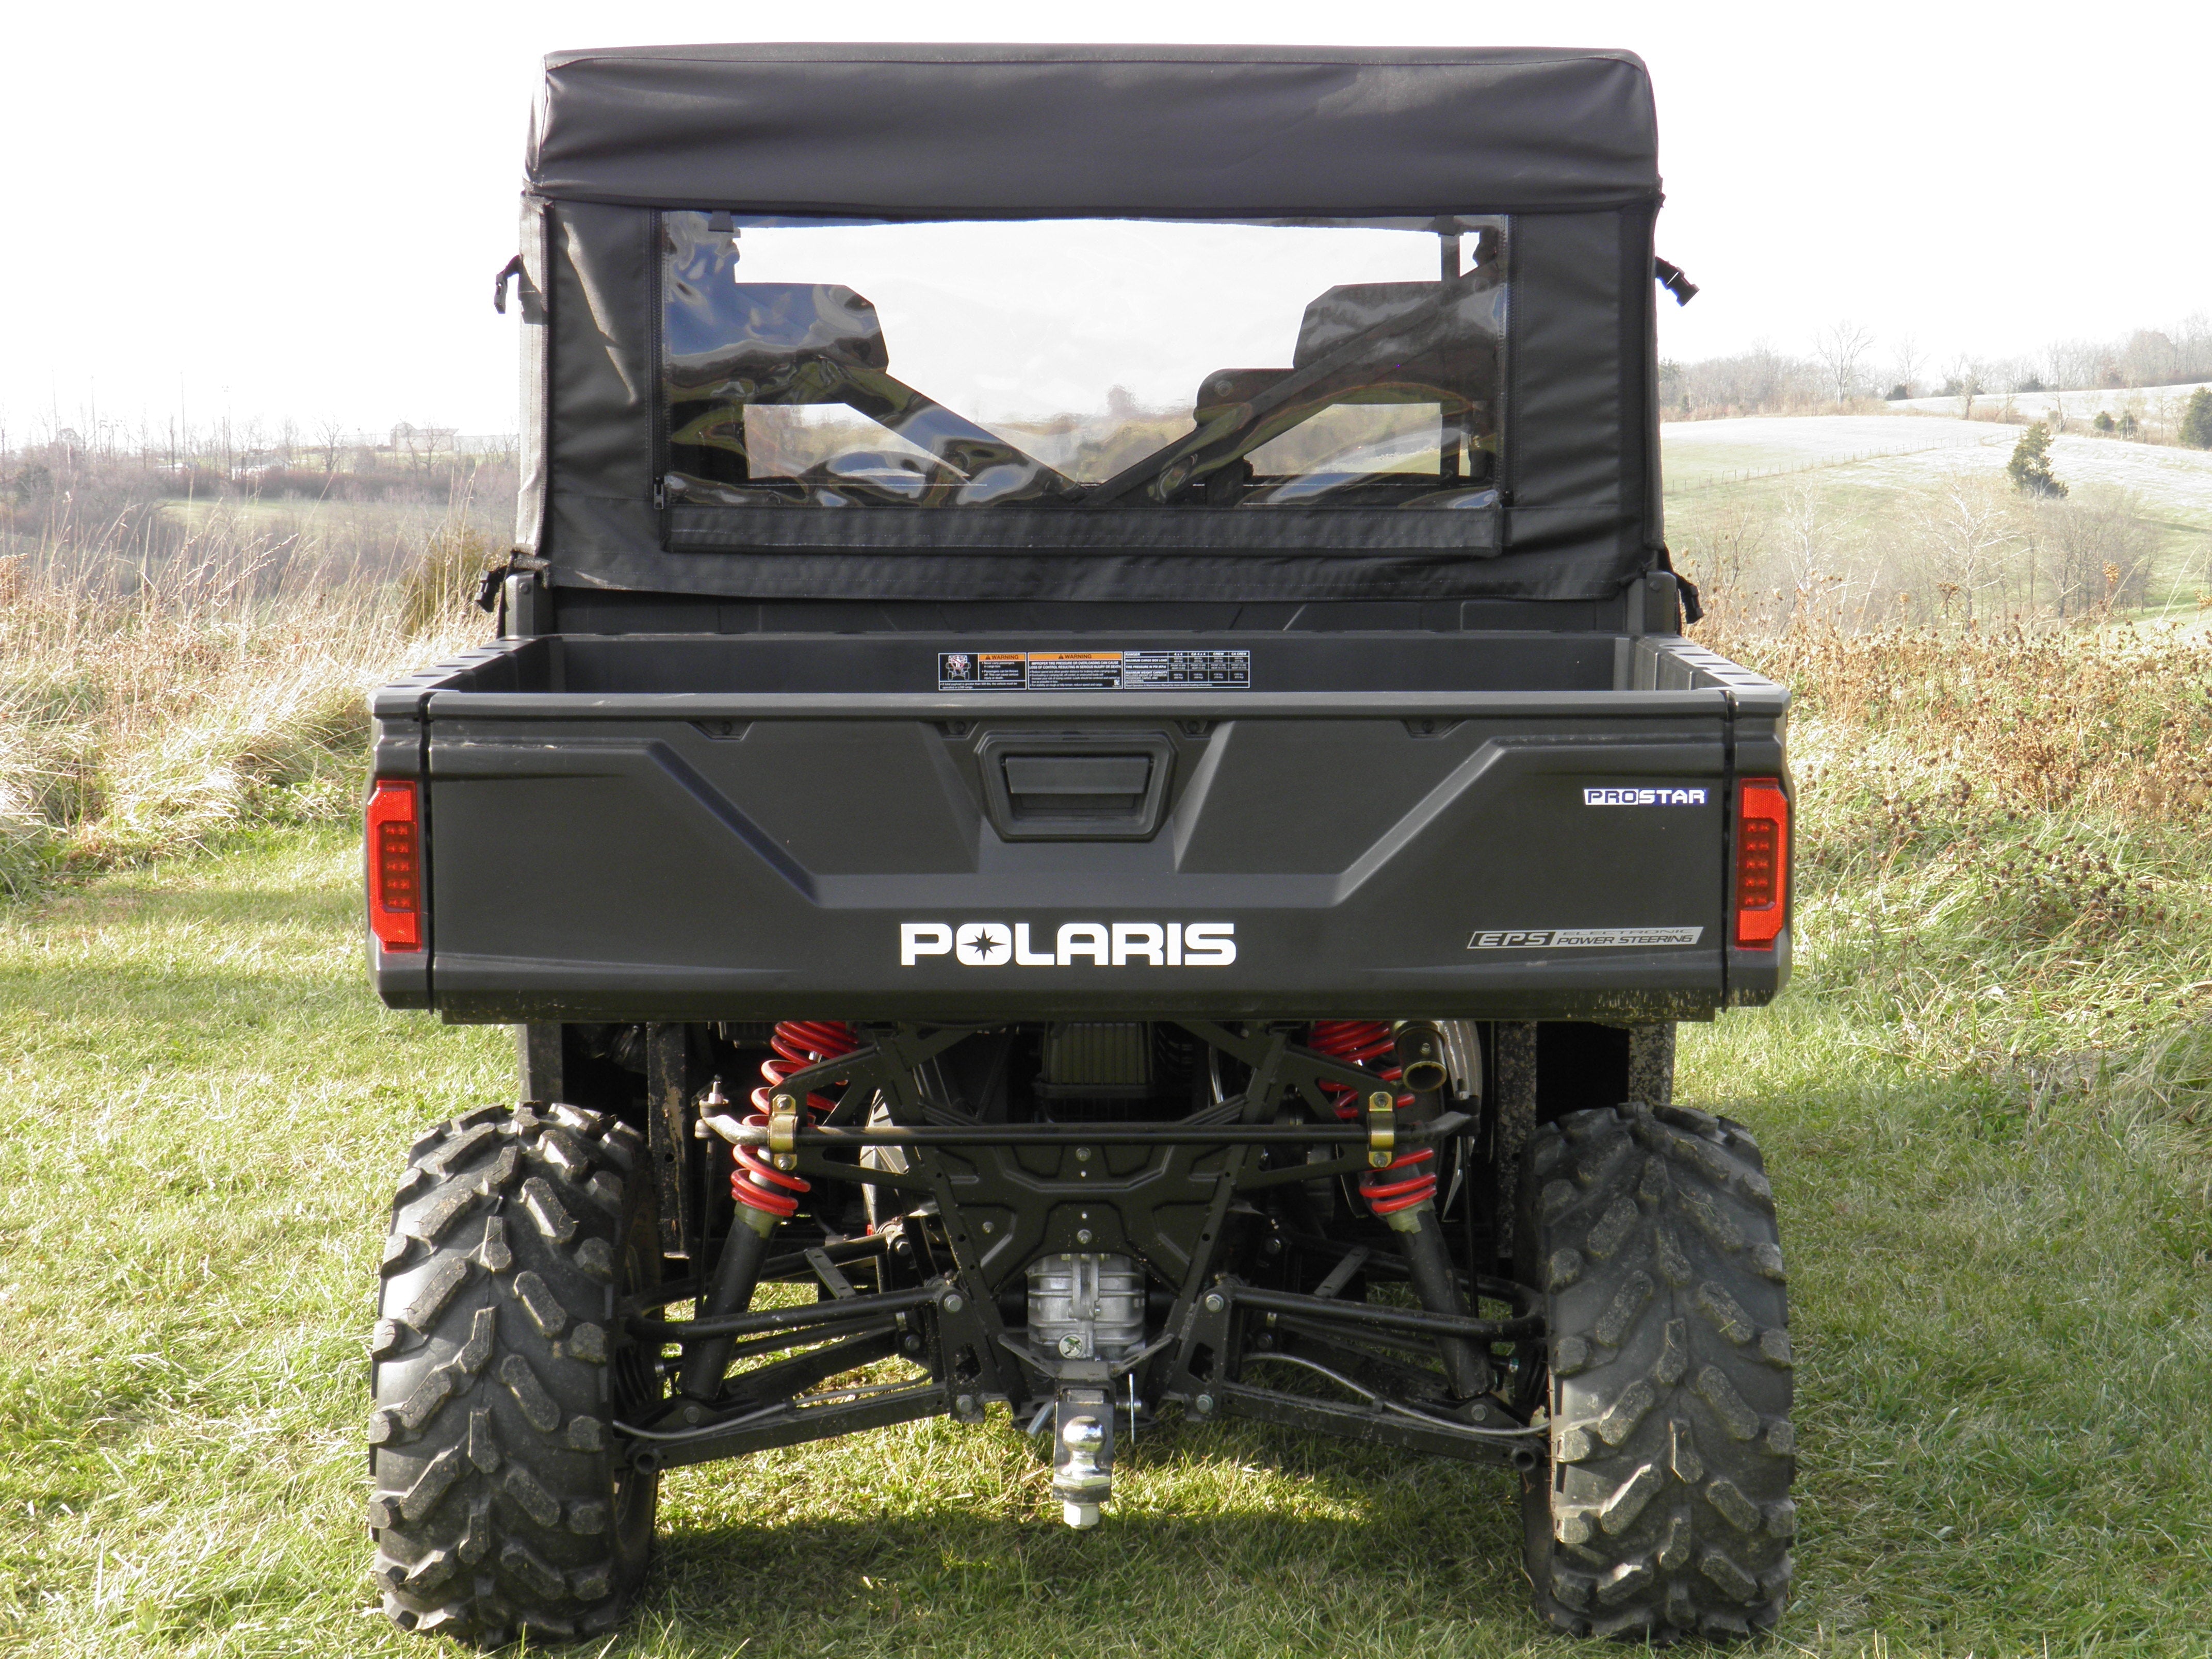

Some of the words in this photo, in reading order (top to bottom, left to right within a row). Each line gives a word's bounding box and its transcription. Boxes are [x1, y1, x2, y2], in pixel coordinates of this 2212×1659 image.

[1585, 789, 1705, 804] PROSTAR
[901, 923, 1236, 966] POLARIS
[1478, 932, 1549, 946] EPS
[1557, 936, 1615, 945] POWER
[1618, 934, 1693, 944] STEERING
